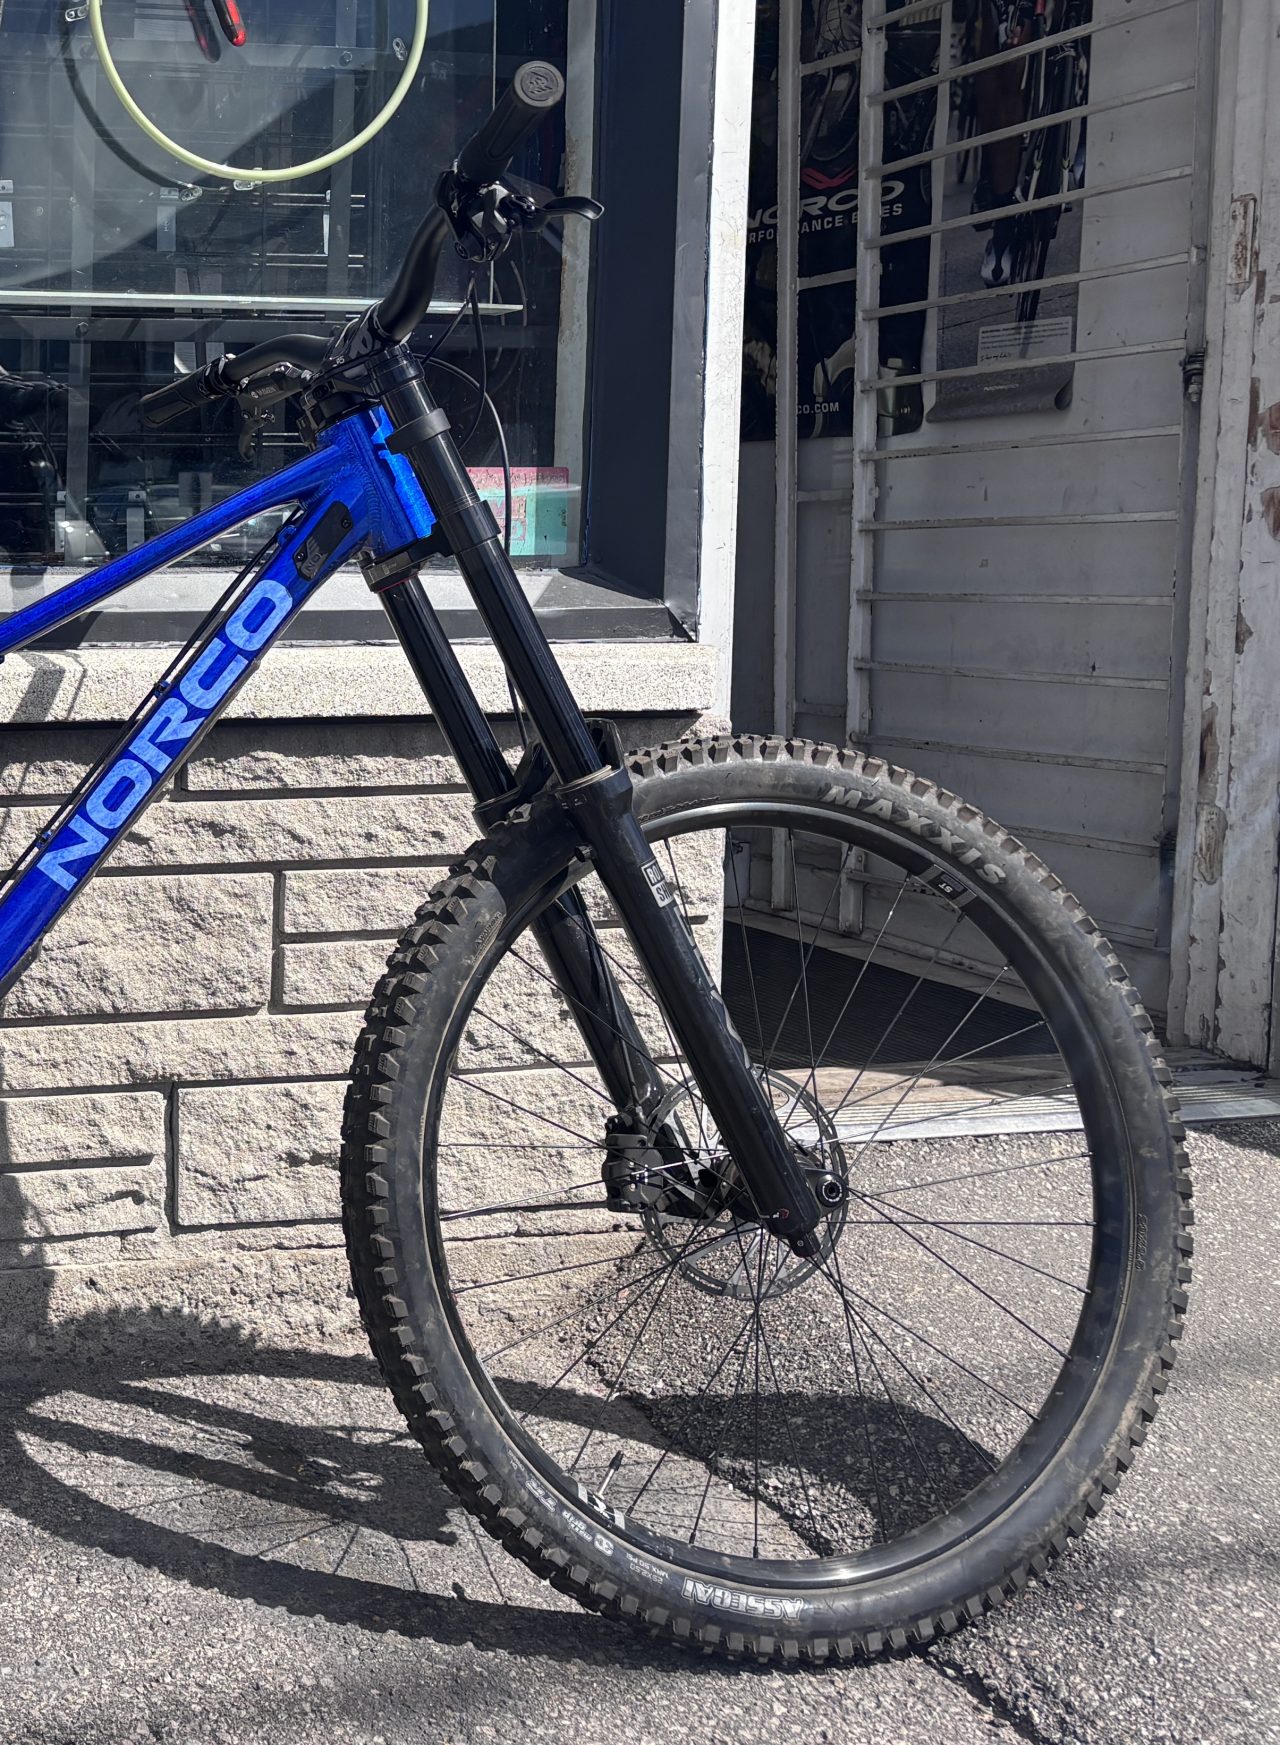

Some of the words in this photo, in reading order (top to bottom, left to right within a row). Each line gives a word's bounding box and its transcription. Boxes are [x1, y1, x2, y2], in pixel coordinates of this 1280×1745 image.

[797, 402, 840, 415] CO.COM
[36, 579, 293, 891] NORCO
[820, 785, 1007, 885] MAXXIS
[681, 1576, 803, 1621] ASSEGAI
